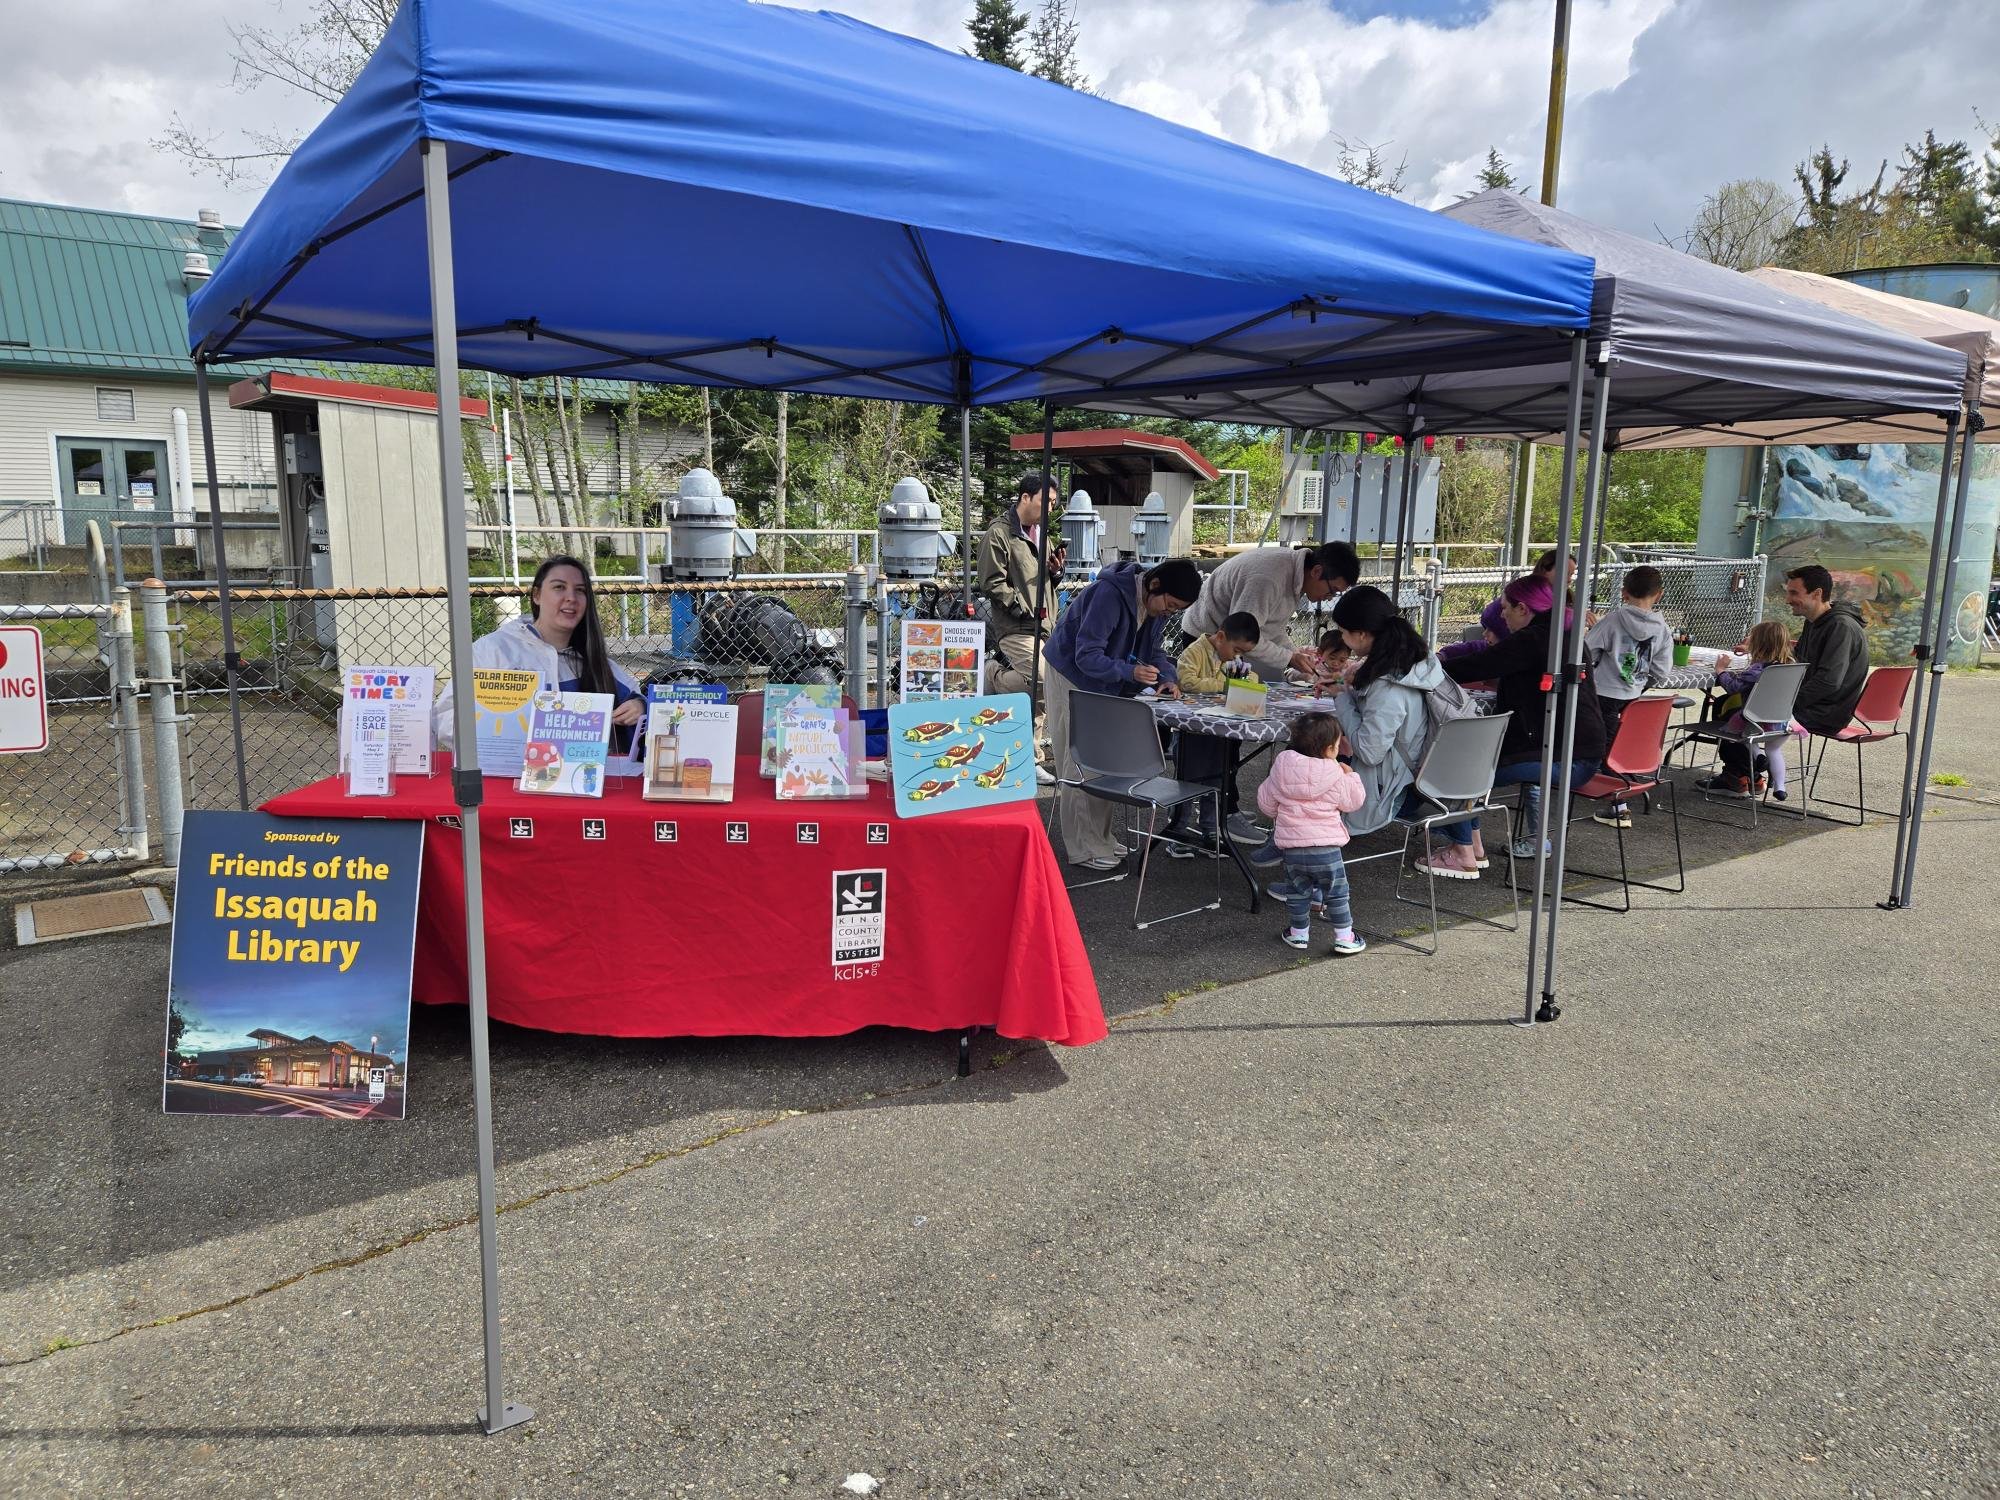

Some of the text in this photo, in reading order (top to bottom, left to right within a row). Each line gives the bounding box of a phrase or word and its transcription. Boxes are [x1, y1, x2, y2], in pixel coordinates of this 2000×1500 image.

[944, 627, 966, 635] CHOOSE
[350, 673, 410, 686] STORY
[473, 671, 536, 682] SOLAR ENERGY
[0, 677, 36, 698] ING
[479, 681, 528, 691] WORKSHOP
[350, 687, 406, 700] TIMES
[544, 713, 592, 728] HELP the
[690, 710, 730, 719] UPCYCLE
[362, 722, 386, 730] SALE
[800, 720, 827, 730] CRAFTY
[533, 728, 601, 741] ENVIRONMENT
[567, 746, 601, 758] Crafts
[264, 830, 340, 845] Sponsored by
[209, 852, 390, 880] Friends of the
[214, 887, 378, 928] Issaquah
[838, 915, 879, 924] KING
[838, 927, 879, 936] COUNTY
[838, 938, 878, 948] LIBRARY
[227, 929, 361, 972] Library
[838, 947, 878, 959] SYSTEM
